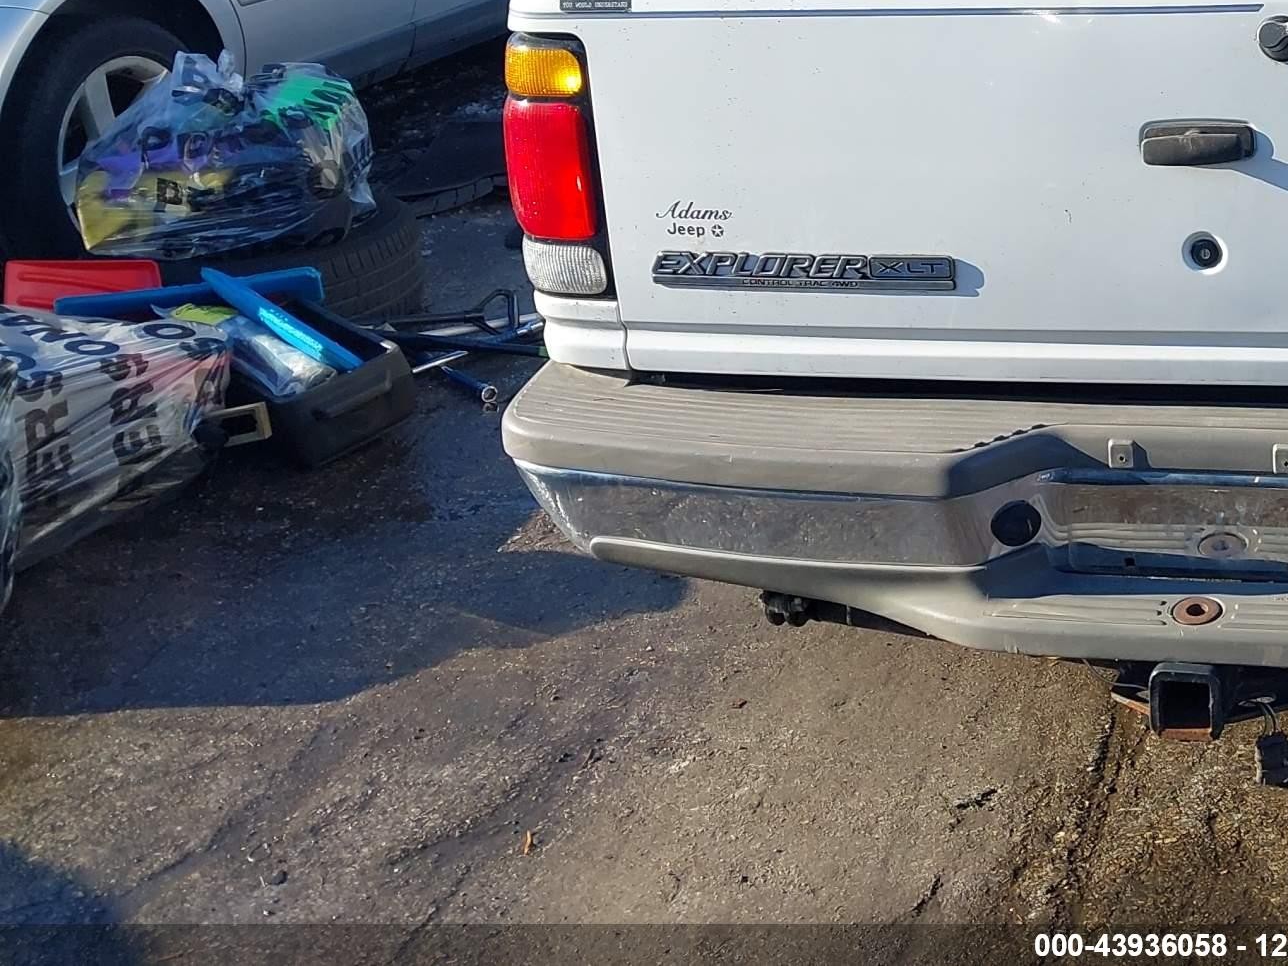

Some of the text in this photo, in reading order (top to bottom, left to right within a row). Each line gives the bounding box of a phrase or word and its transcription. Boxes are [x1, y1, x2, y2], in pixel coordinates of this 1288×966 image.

[655, 200, 733, 221] Adams
[667, 222, 705, 238] Jeep
[653, 250, 944, 278] EXPLORER XLT
[831, 280, 859, 288] 4WD
